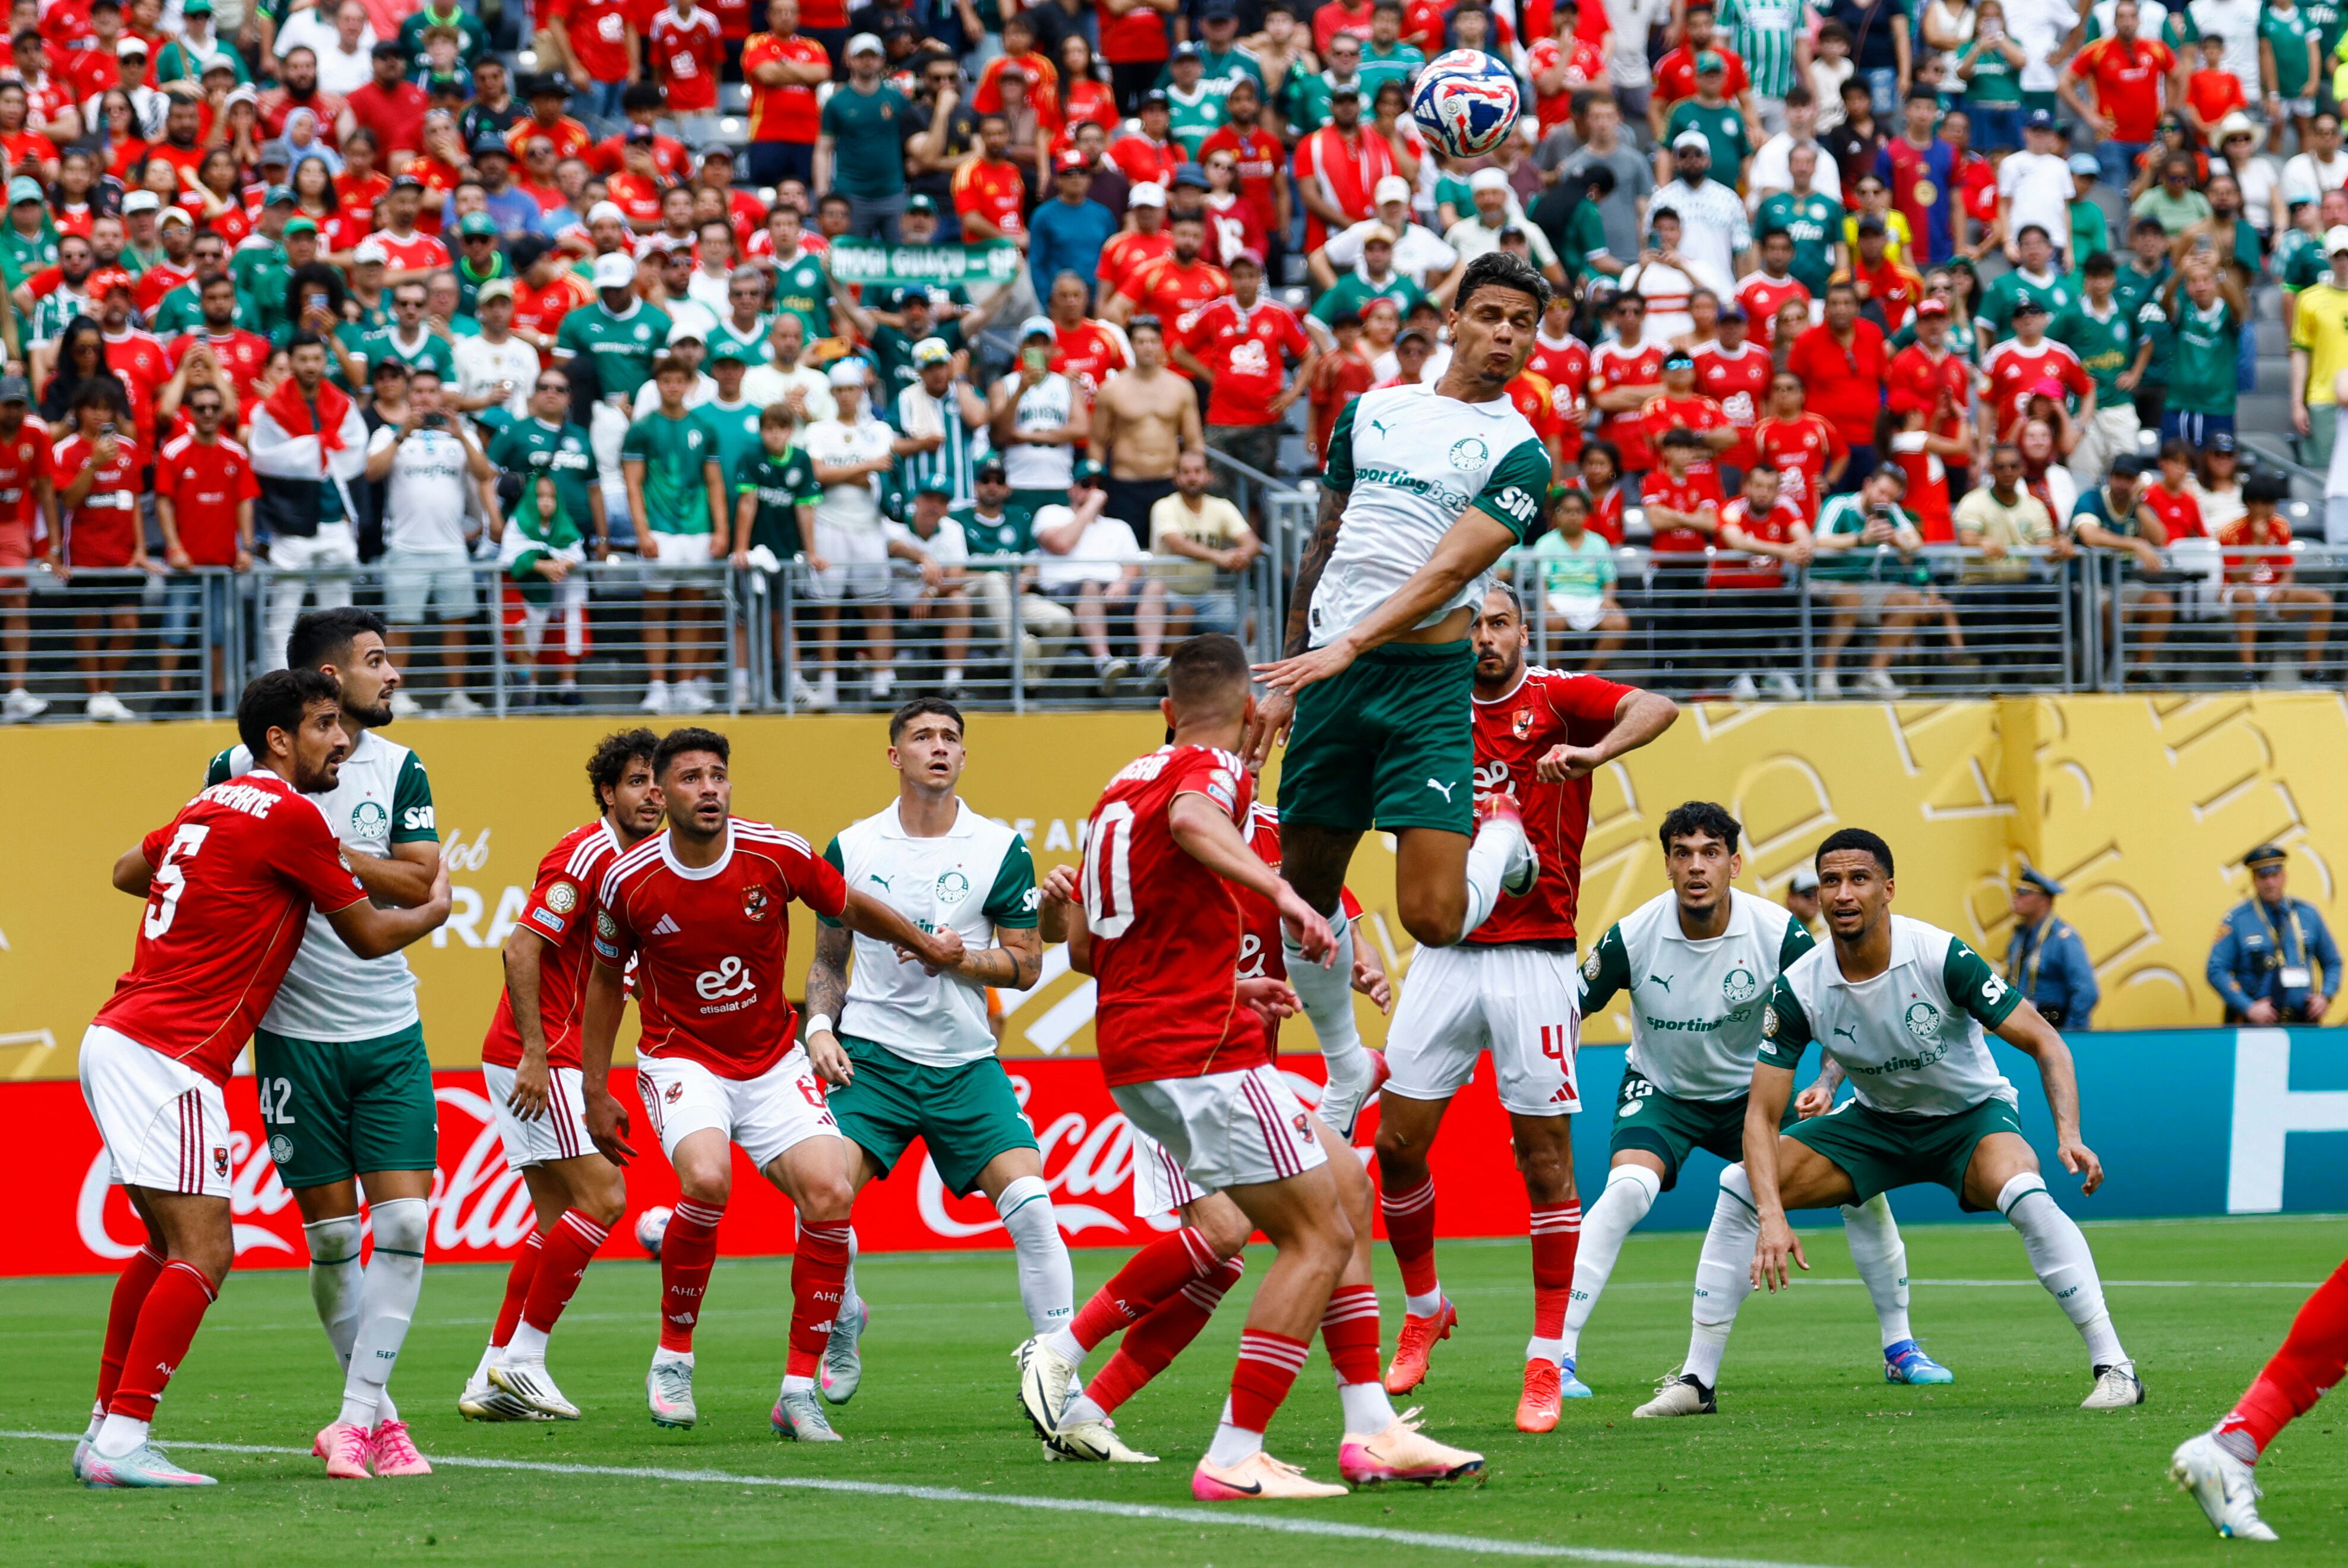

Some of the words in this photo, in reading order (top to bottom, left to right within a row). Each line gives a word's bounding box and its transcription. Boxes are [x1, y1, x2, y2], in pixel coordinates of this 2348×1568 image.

[1355, 467, 1471, 512] sportingbet
[404, 805, 435, 830] Sil
[144, 823, 211, 940] 5
[700, 1000, 740, 1014] etisalat
[741, 993, 758, 1009] and
[1541, 1025, 1569, 1077] 4
[260, 1077, 296, 1124] 42
[795, 1074, 827, 1109] 6
[1625, 1080, 1654, 1100] 15
[671, 1285, 705, 1297] AHLY
[2057, 1286, 2078, 1299] SEP
[1048, 1307, 1069, 1317] SEP
[377, 1349, 396, 1360] SEP
